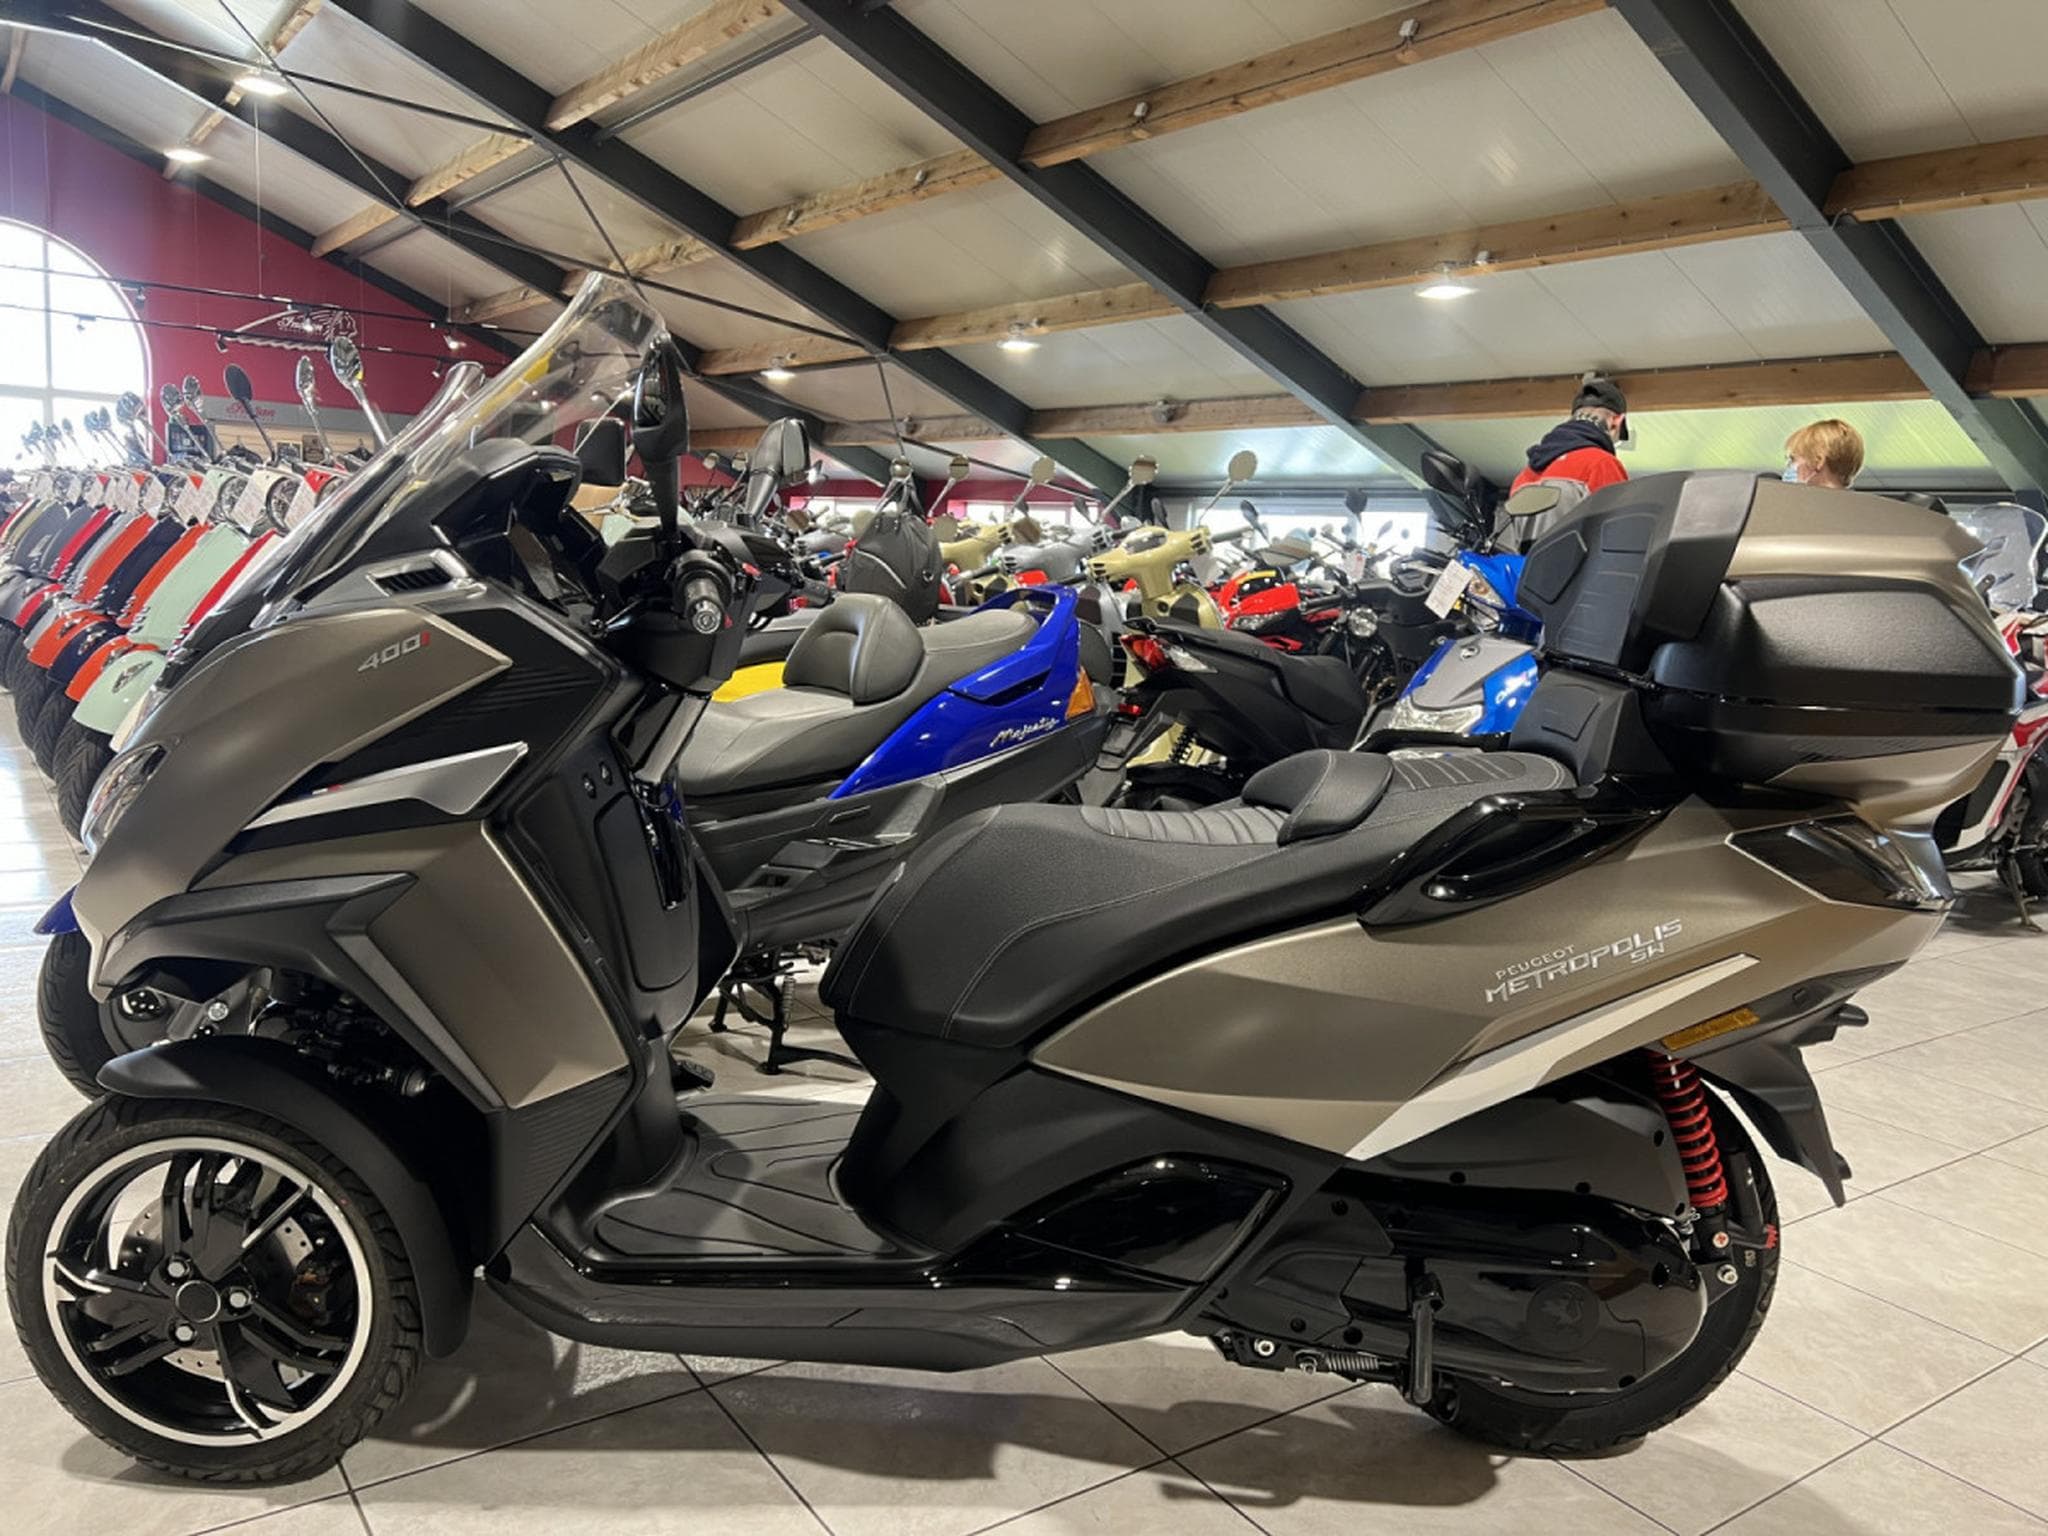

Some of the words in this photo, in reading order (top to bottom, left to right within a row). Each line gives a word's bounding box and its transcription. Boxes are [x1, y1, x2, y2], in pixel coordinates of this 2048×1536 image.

[989, 717, 1060, 747] Majesty
[1485, 919, 1682, 1003] METROPOLIS
[1496, 944, 1575, 980] PEUGEOT
[1631, 942, 1665, 964] SW
